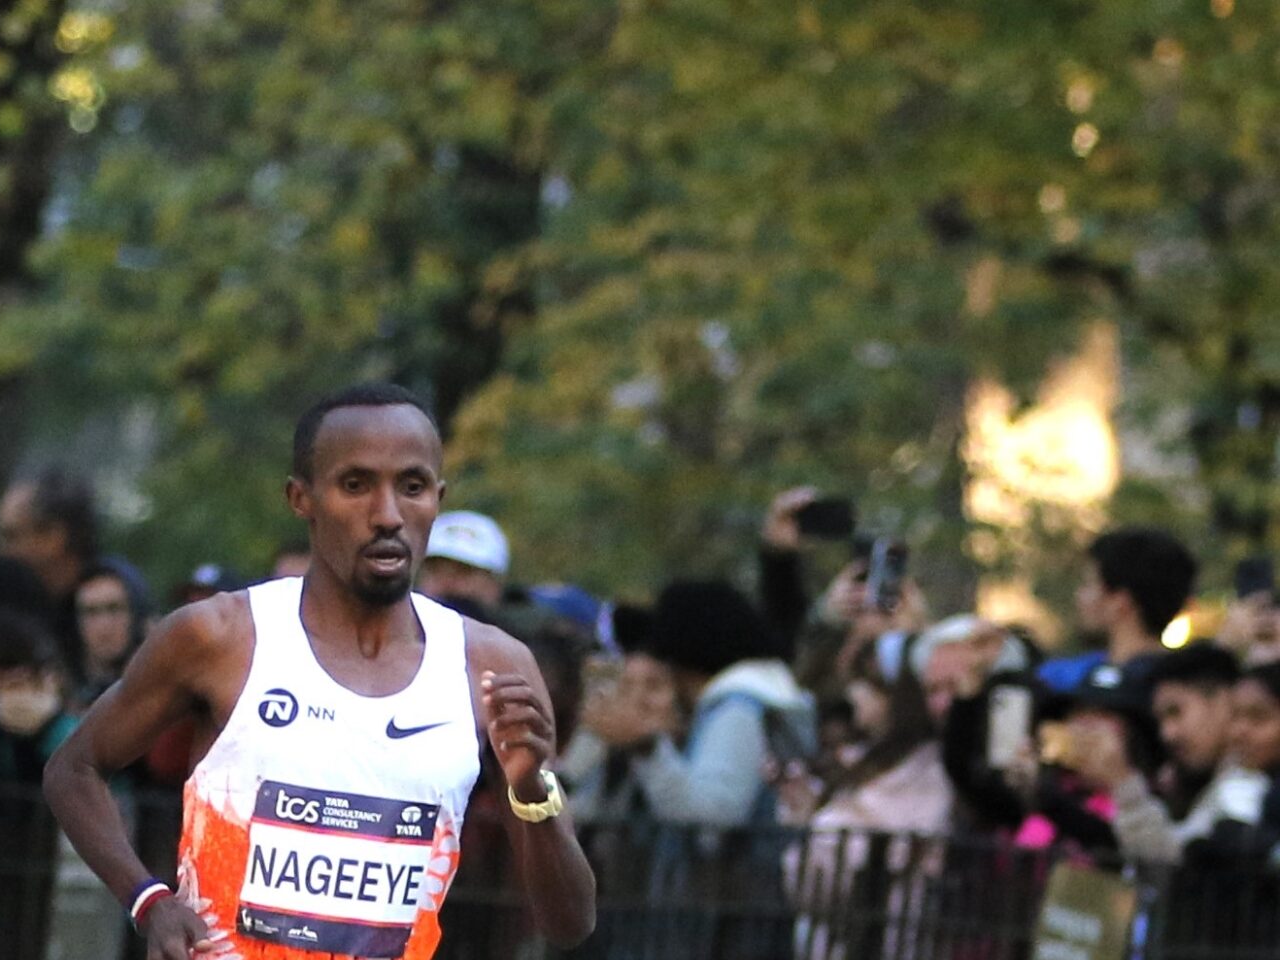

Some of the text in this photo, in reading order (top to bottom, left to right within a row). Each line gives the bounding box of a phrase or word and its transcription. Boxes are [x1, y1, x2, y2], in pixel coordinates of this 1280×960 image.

[307, 705, 335, 721] NN
[275, 789, 320, 823] tcs
[325, 797, 350, 808] TATA
[321, 817, 359, 829] SERVICES
[322, 807, 382, 823] CONSULTANCY
[396, 825, 422, 836] TATA
[250, 844, 424, 905] NAGEEYE
